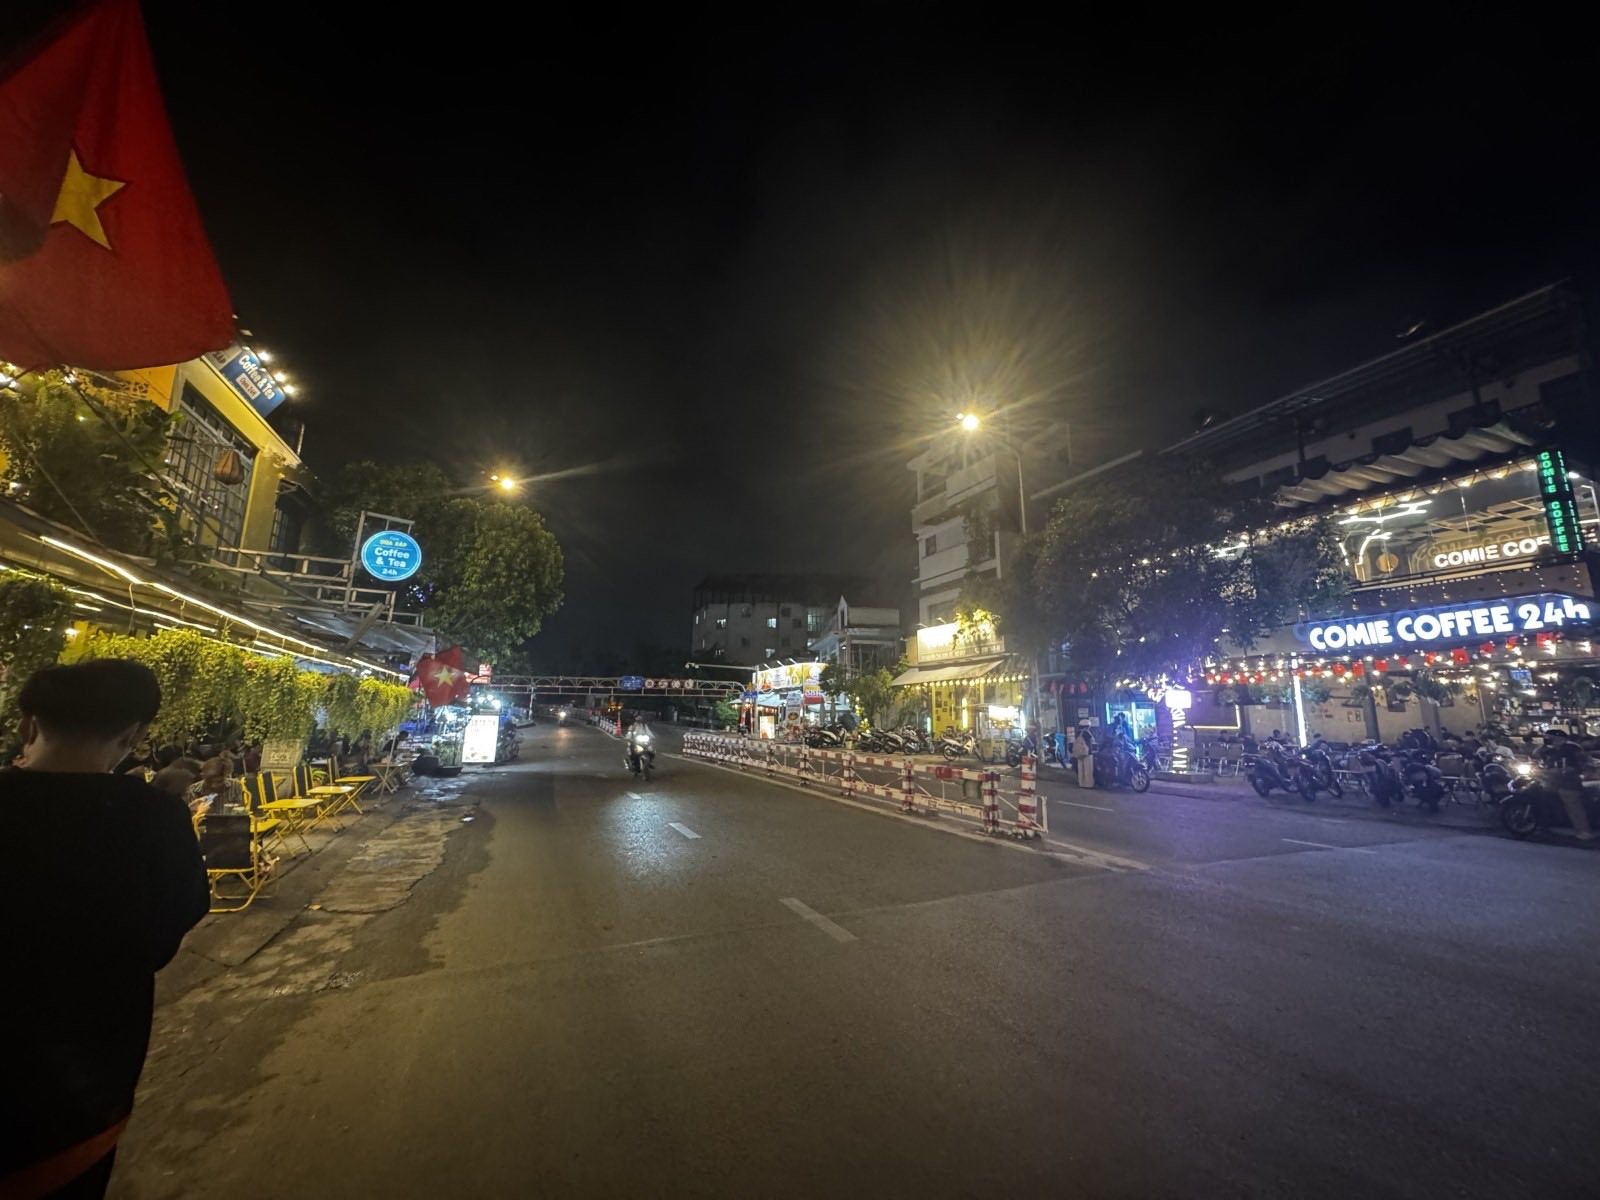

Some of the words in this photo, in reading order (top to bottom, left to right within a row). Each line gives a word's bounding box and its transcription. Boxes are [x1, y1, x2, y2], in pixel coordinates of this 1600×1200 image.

[239, 354, 262, 383] Coffee
[257, 378, 268, 389] &
[262, 382, 275, 400] Tea
[1540, 451, 1557, 493] COMIE
[1550, 501, 1570, 552] COFFEE
[374, 547, 410, 559] Coffee
[375, 557, 384, 565] &
[388, 557, 406, 567] Tea
[1434, 544, 1500, 568] COMIE
[382, 568, 398, 576] 24h
[1309, 620, 1394, 651] COMIE
[1396, 605, 1514, 642] COFFEE
[1517, 598, 1591, 630] 24h
